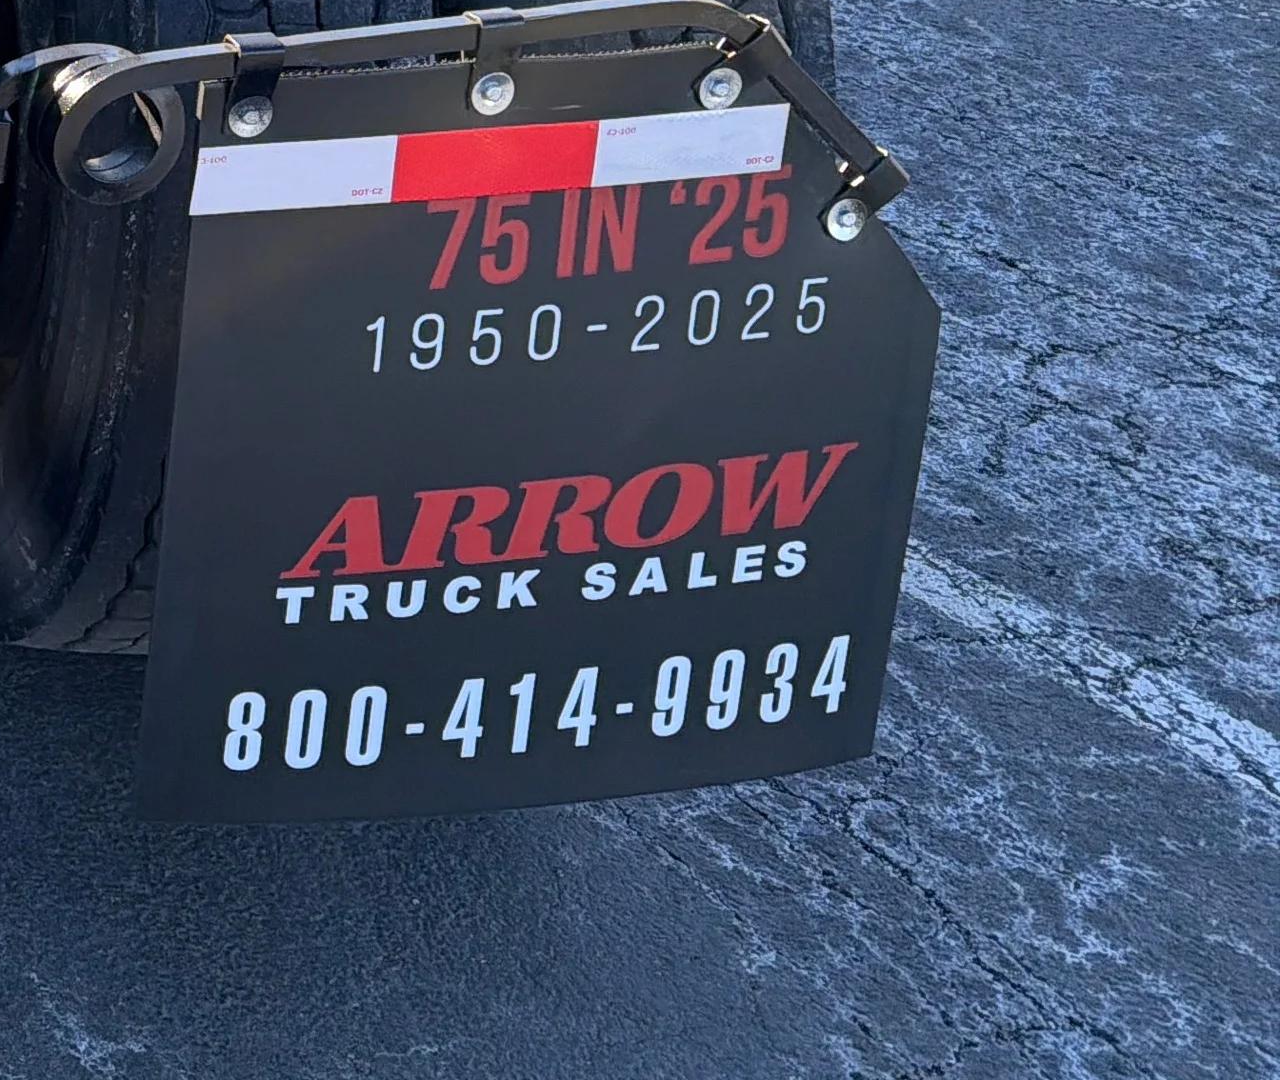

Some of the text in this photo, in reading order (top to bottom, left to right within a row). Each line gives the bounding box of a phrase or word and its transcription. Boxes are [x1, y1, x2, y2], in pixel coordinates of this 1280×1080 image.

[426, 192, 533, 291] 75
[556, 186, 642, 280] IN
[366, 276, 830, 374] 1950-2025
[279, 442, 859, 580] ARROW
[275, 539, 808, 625] TRUCK SALES
[223, 634, 851, 771] 800-414-9934
